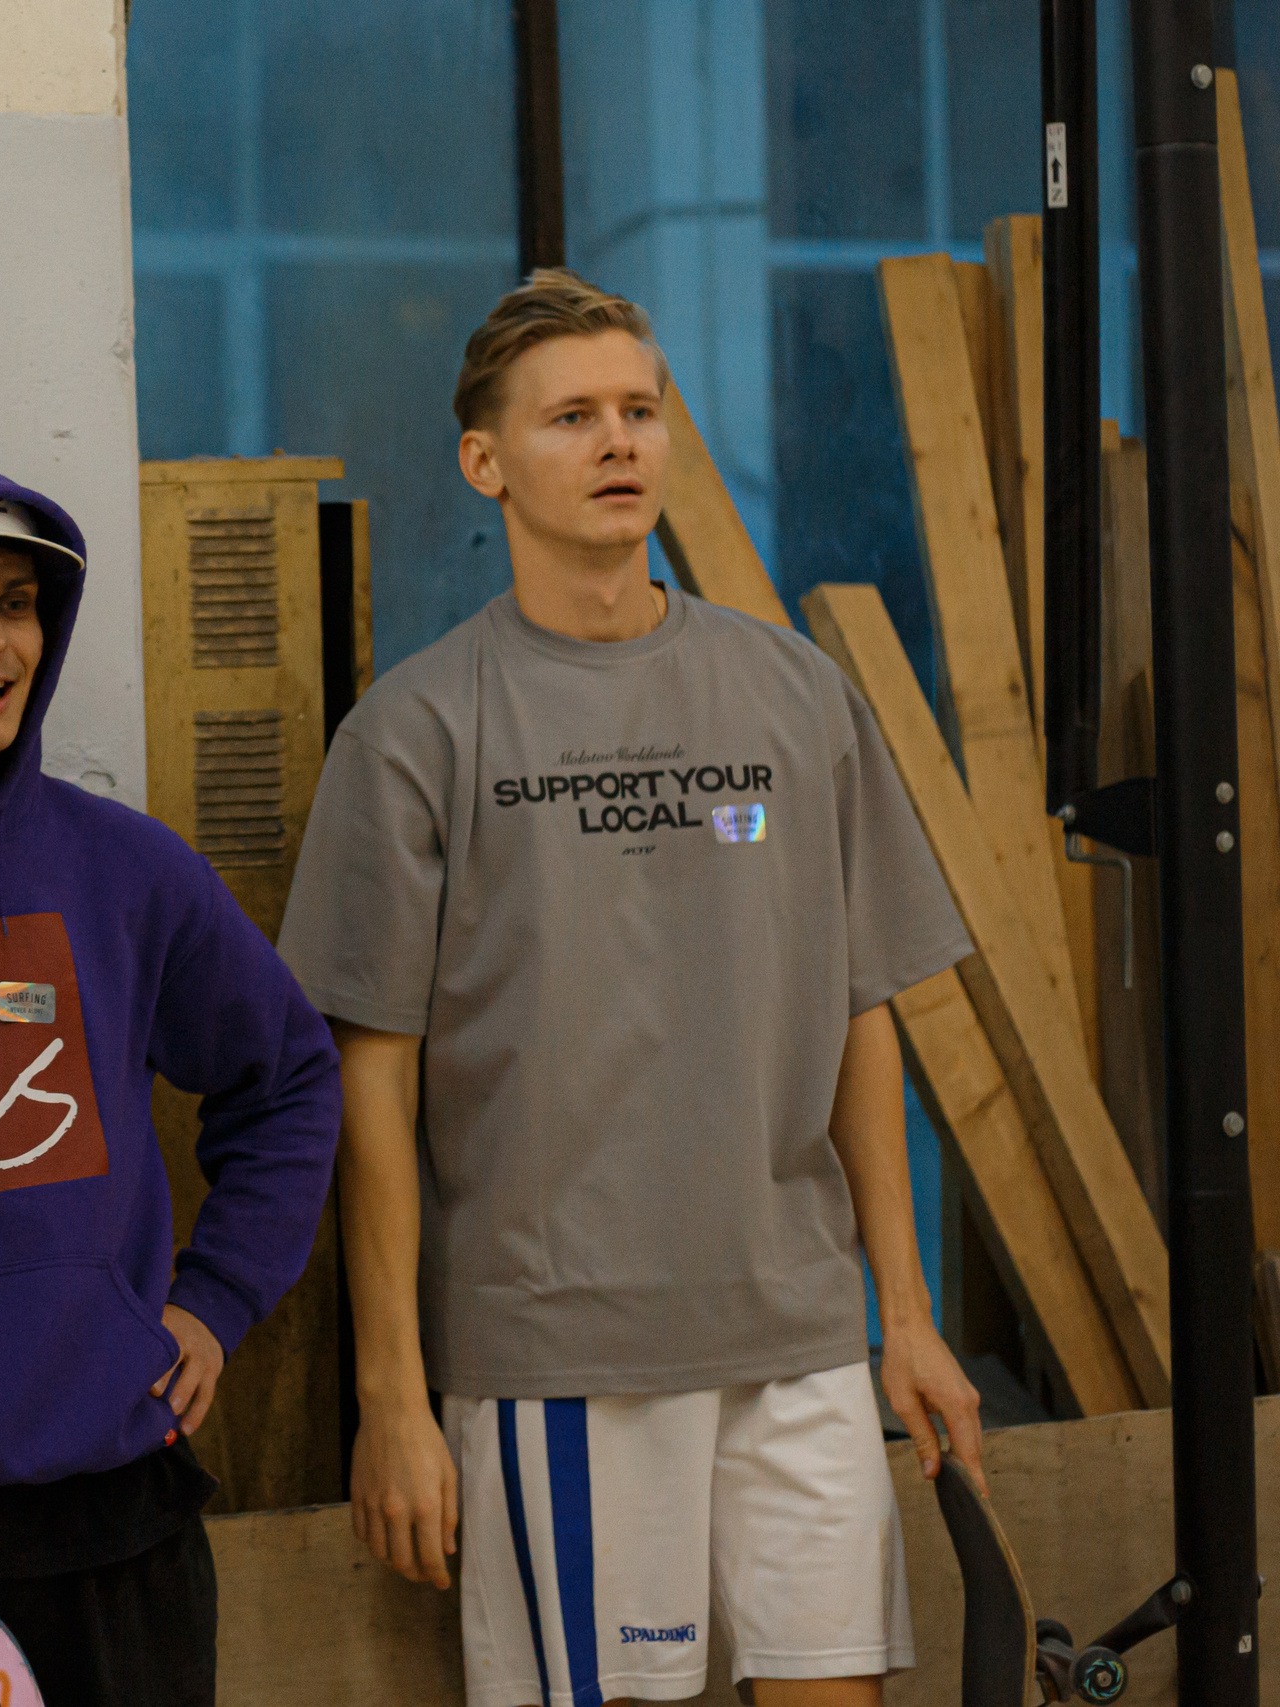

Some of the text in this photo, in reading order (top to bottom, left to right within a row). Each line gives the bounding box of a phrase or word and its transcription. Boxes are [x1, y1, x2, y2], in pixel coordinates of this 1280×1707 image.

[493, 764, 773, 807] SUPPORT YOUR
[578, 802, 703, 834] LOCAL
[6, 993, 47, 1005] SURFING
[620, 1624, 696, 1643] SPALDING
